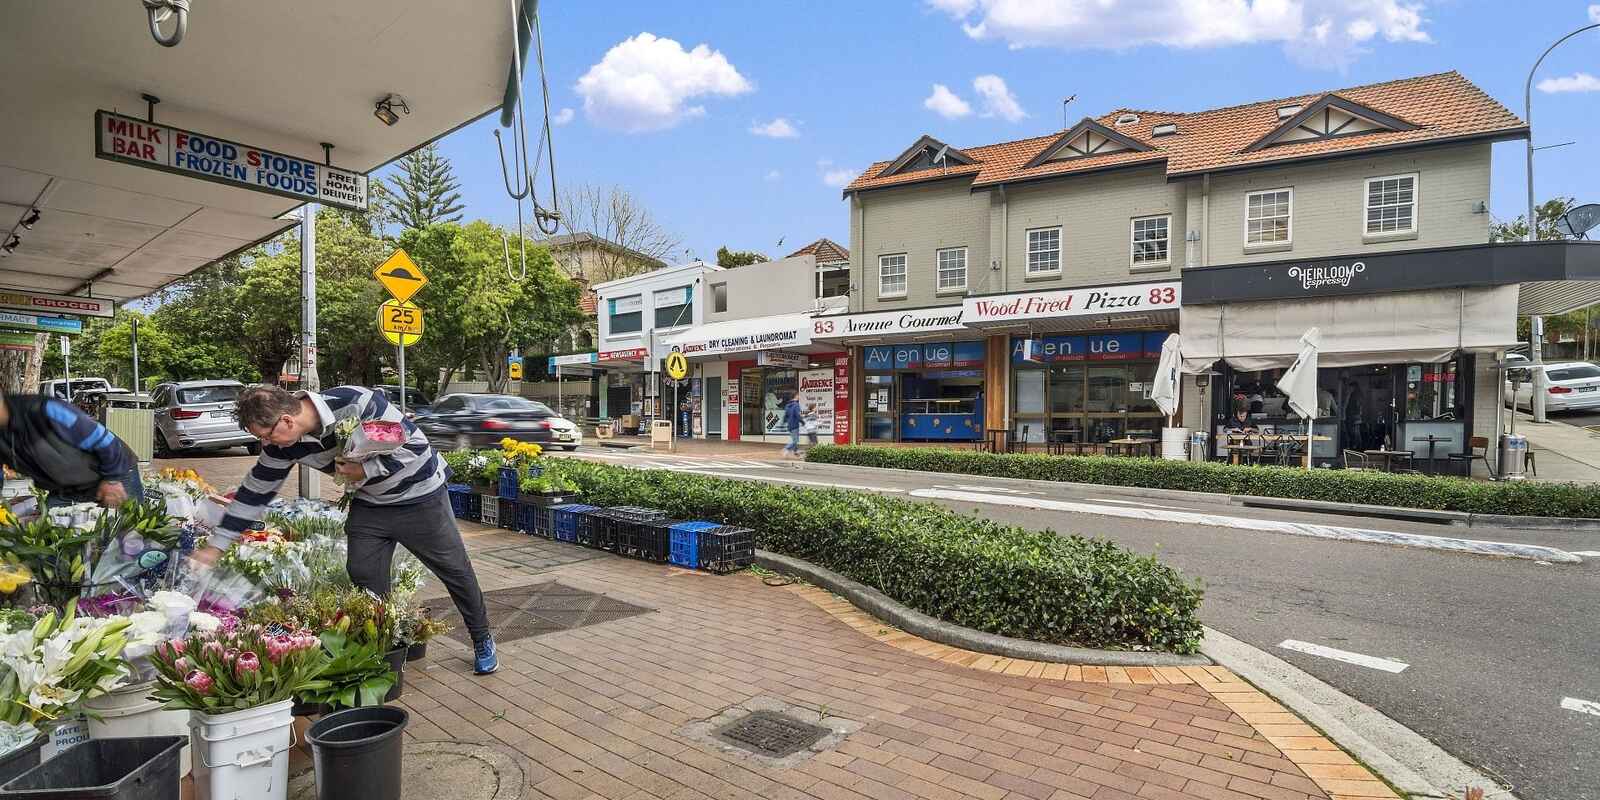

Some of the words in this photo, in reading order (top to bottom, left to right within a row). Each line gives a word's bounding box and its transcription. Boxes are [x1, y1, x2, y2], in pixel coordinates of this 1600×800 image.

[107, 117, 162, 145] MILK
[112, 136, 156, 162] BAR
[176, 132, 237, 161] FOOD
[246, 150, 316, 180] STORE
[175, 152, 247, 181] FROZEN
[256, 167, 318, 196] FOODS
[328, 172, 357, 185] FREE
[322, 188, 364, 203] DELIVERY
[326, 180, 361, 194] HOME
[1289, 262, 1365, 289] HEIRLOOM
[1306, 277, 1347, 288] espresso
[36, 299, 99, 311] GROCER
[976, 295, 1073, 317] Wood-Fired
[1083, 292, 1142, 311] Pizza
[1148, 287, 1176, 305] 83
[392, 309, 414, 325] 25
[814, 320, 834, 334] 83
[843, 319, 893, 333] Avenue
[900, 311, 964, 329] Gourmet
[709, 340, 720, 348] DRY
[721, 336, 749, 347] CLEANING
[755, 330, 797, 344] LAUNDROMAT
